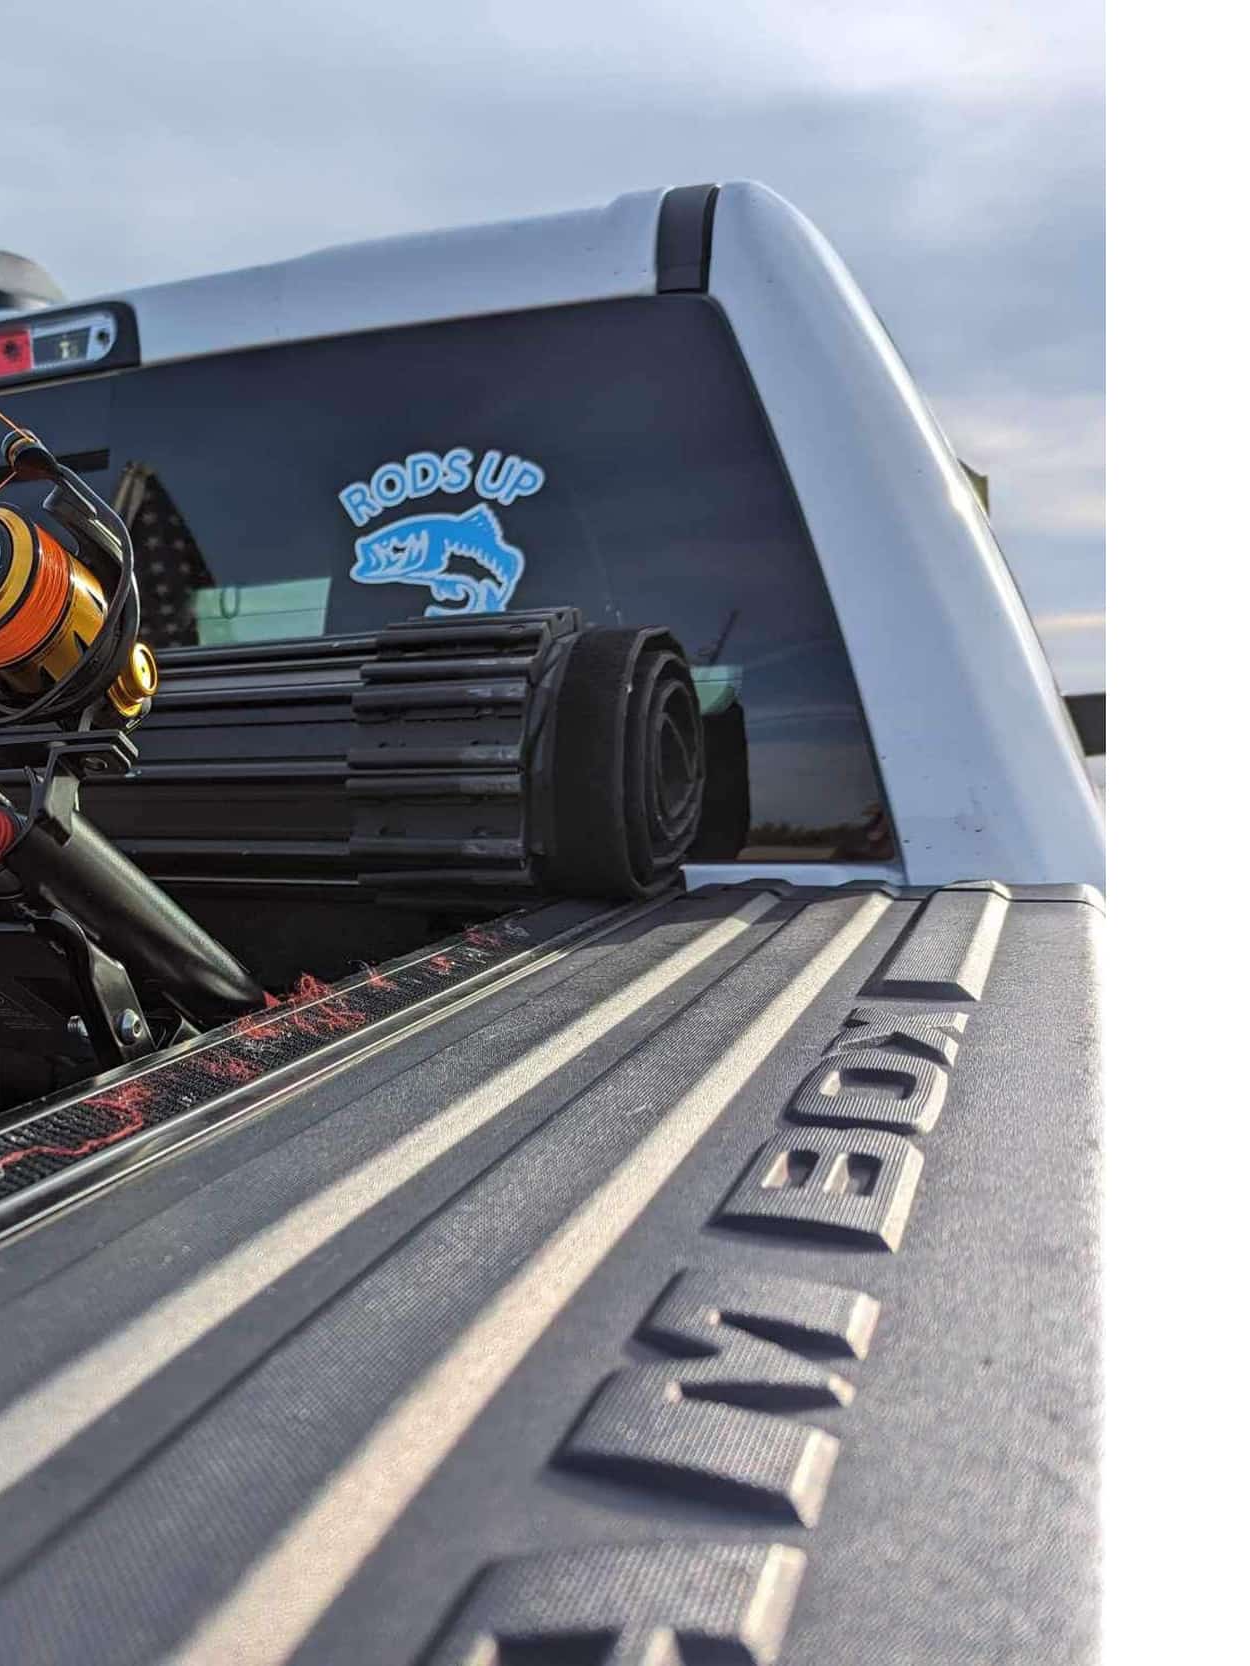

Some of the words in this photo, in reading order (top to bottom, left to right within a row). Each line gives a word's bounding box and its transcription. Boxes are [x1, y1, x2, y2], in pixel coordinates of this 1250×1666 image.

[339, 447, 473, 527] RODS
[474, 450, 545, 505] UP
[704, 1006, 970, 1255] BOX
